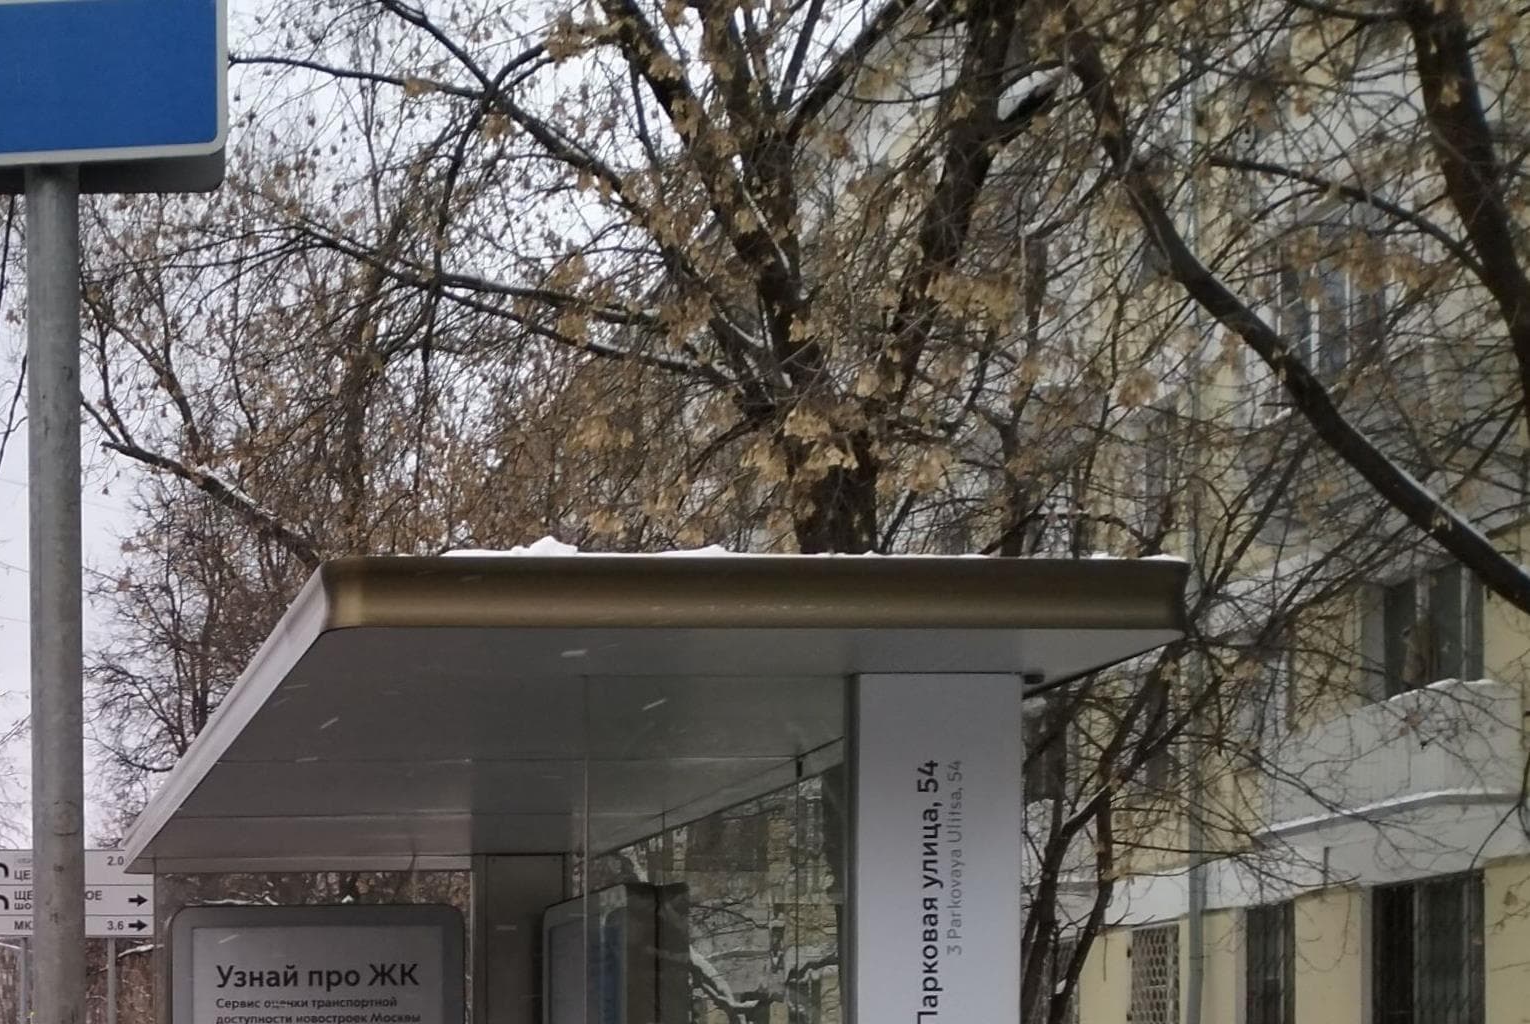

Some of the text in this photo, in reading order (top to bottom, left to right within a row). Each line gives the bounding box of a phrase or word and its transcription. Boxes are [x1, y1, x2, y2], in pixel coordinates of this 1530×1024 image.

[917, 759, 939, 794] 54
[947, 759, 962, 782] 54
[922, 801, 944, 890] улица,
[107, 855, 125, 866] 2.0
[13, 869, 32, 882] ЦЕ
[947, 848, 964, 939] Parkovaya
[13, 920, 33, 930] МК
[107, 920, 125, 931] 3.6
[947, 944, 962, 956] 3
[216, 963, 420, 992] Узнай про ЖК
[215, 998, 261, 1011] Сервис
[312, 996, 398, 1010] транспортной
[296, 1013, 367, 1024] новостроек
[369, 1012, 421, 1023] Москвы
